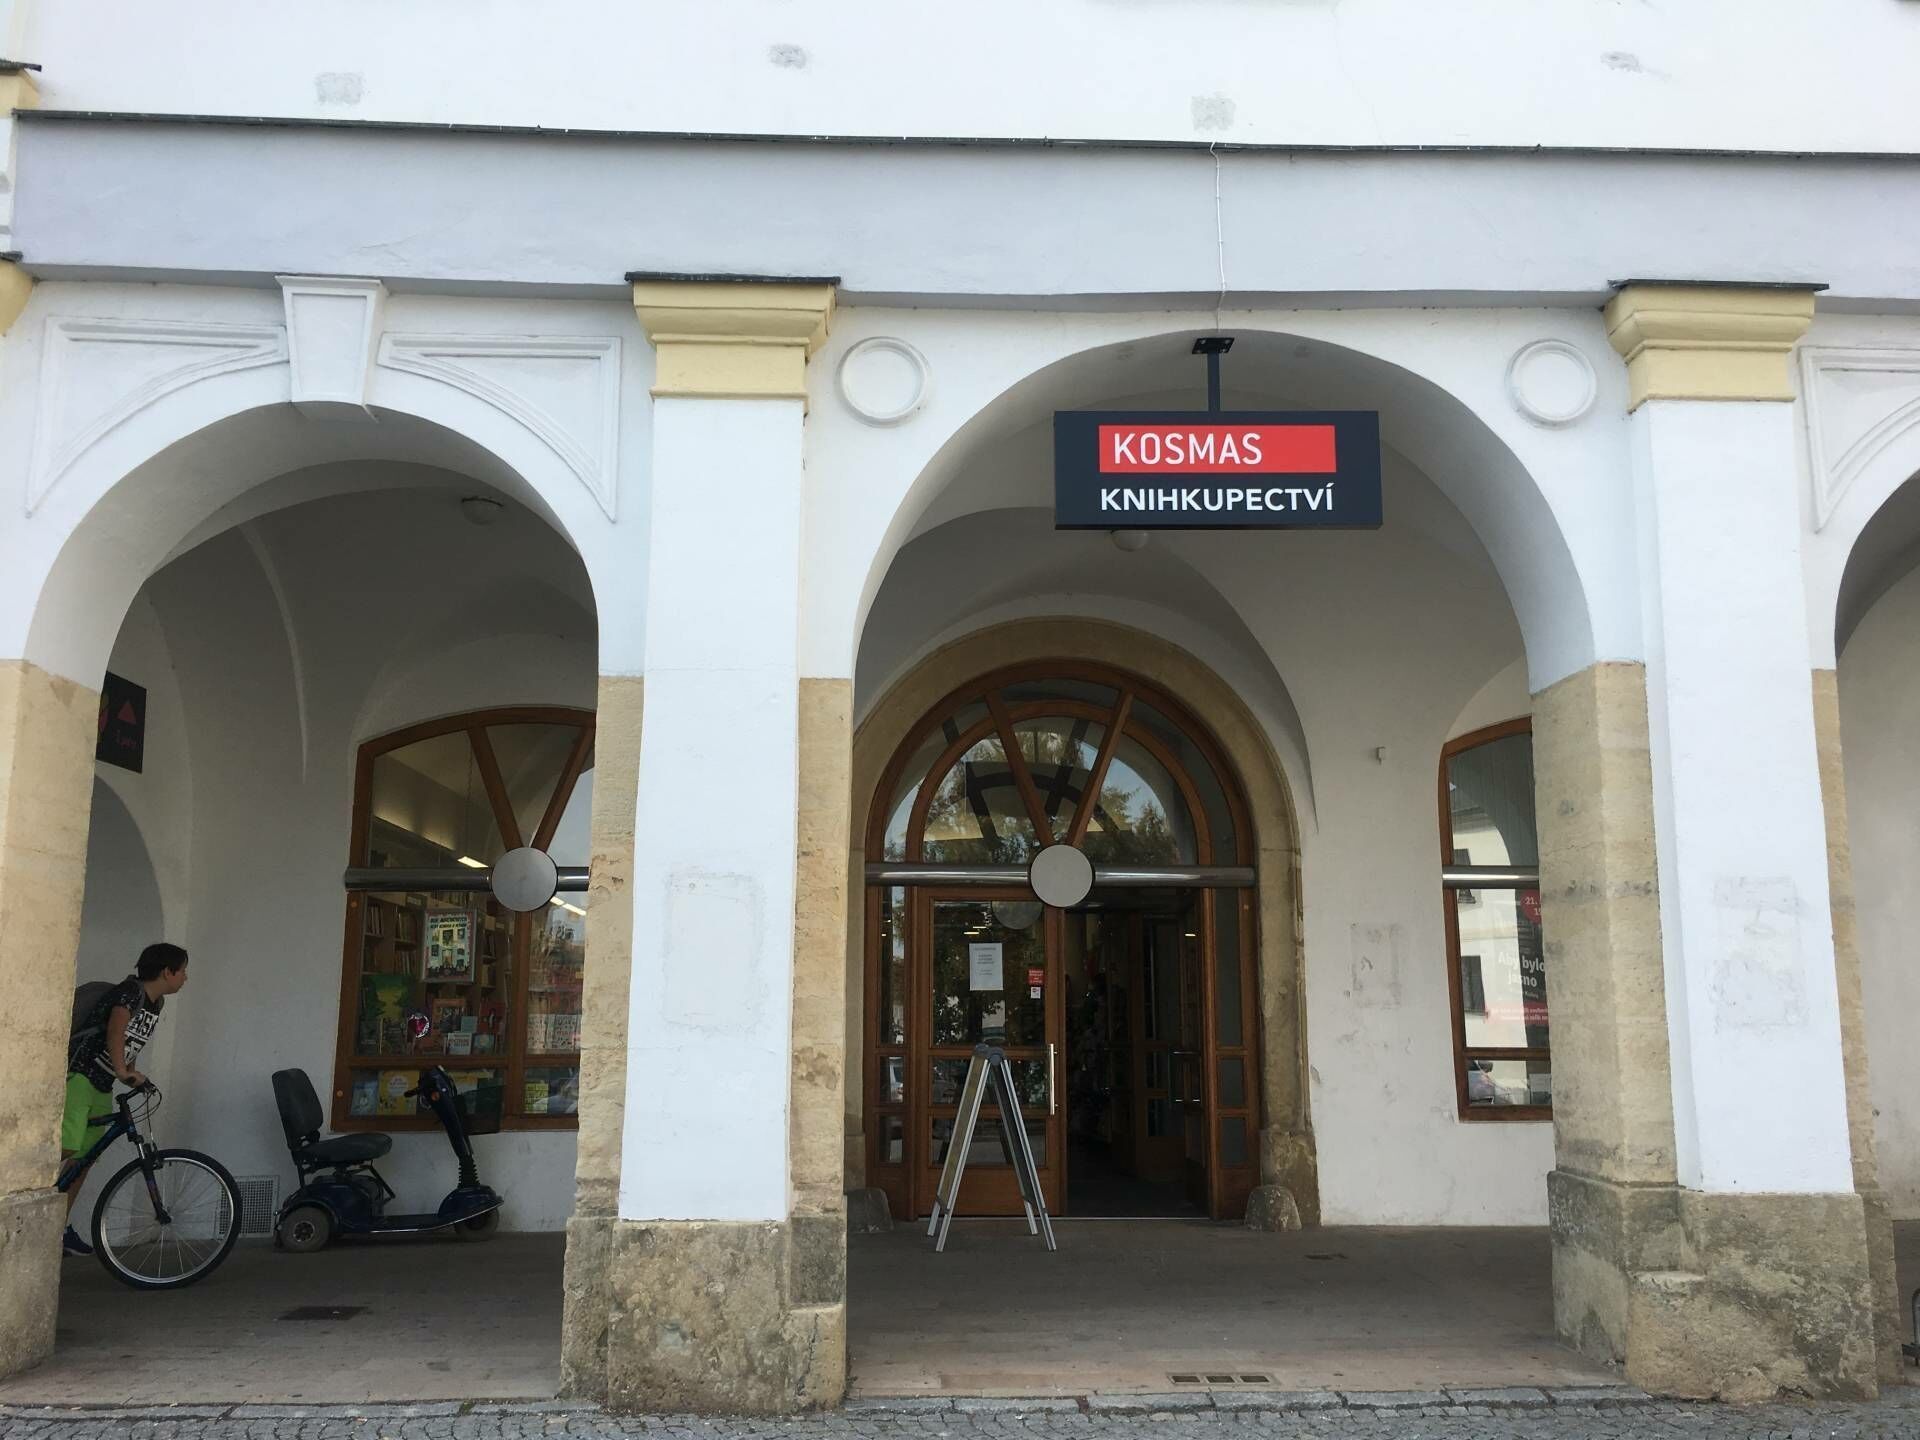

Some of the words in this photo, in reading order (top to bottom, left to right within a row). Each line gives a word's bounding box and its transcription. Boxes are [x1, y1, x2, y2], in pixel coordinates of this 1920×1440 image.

[1113, 432, 1263, 465] KOSMAS
[1100, 482, 1335, 511] KNIHKUPECTVÍ
[1498, 951, 1519, 970] Aby
[1522, 955, 1545, 974] bylo
